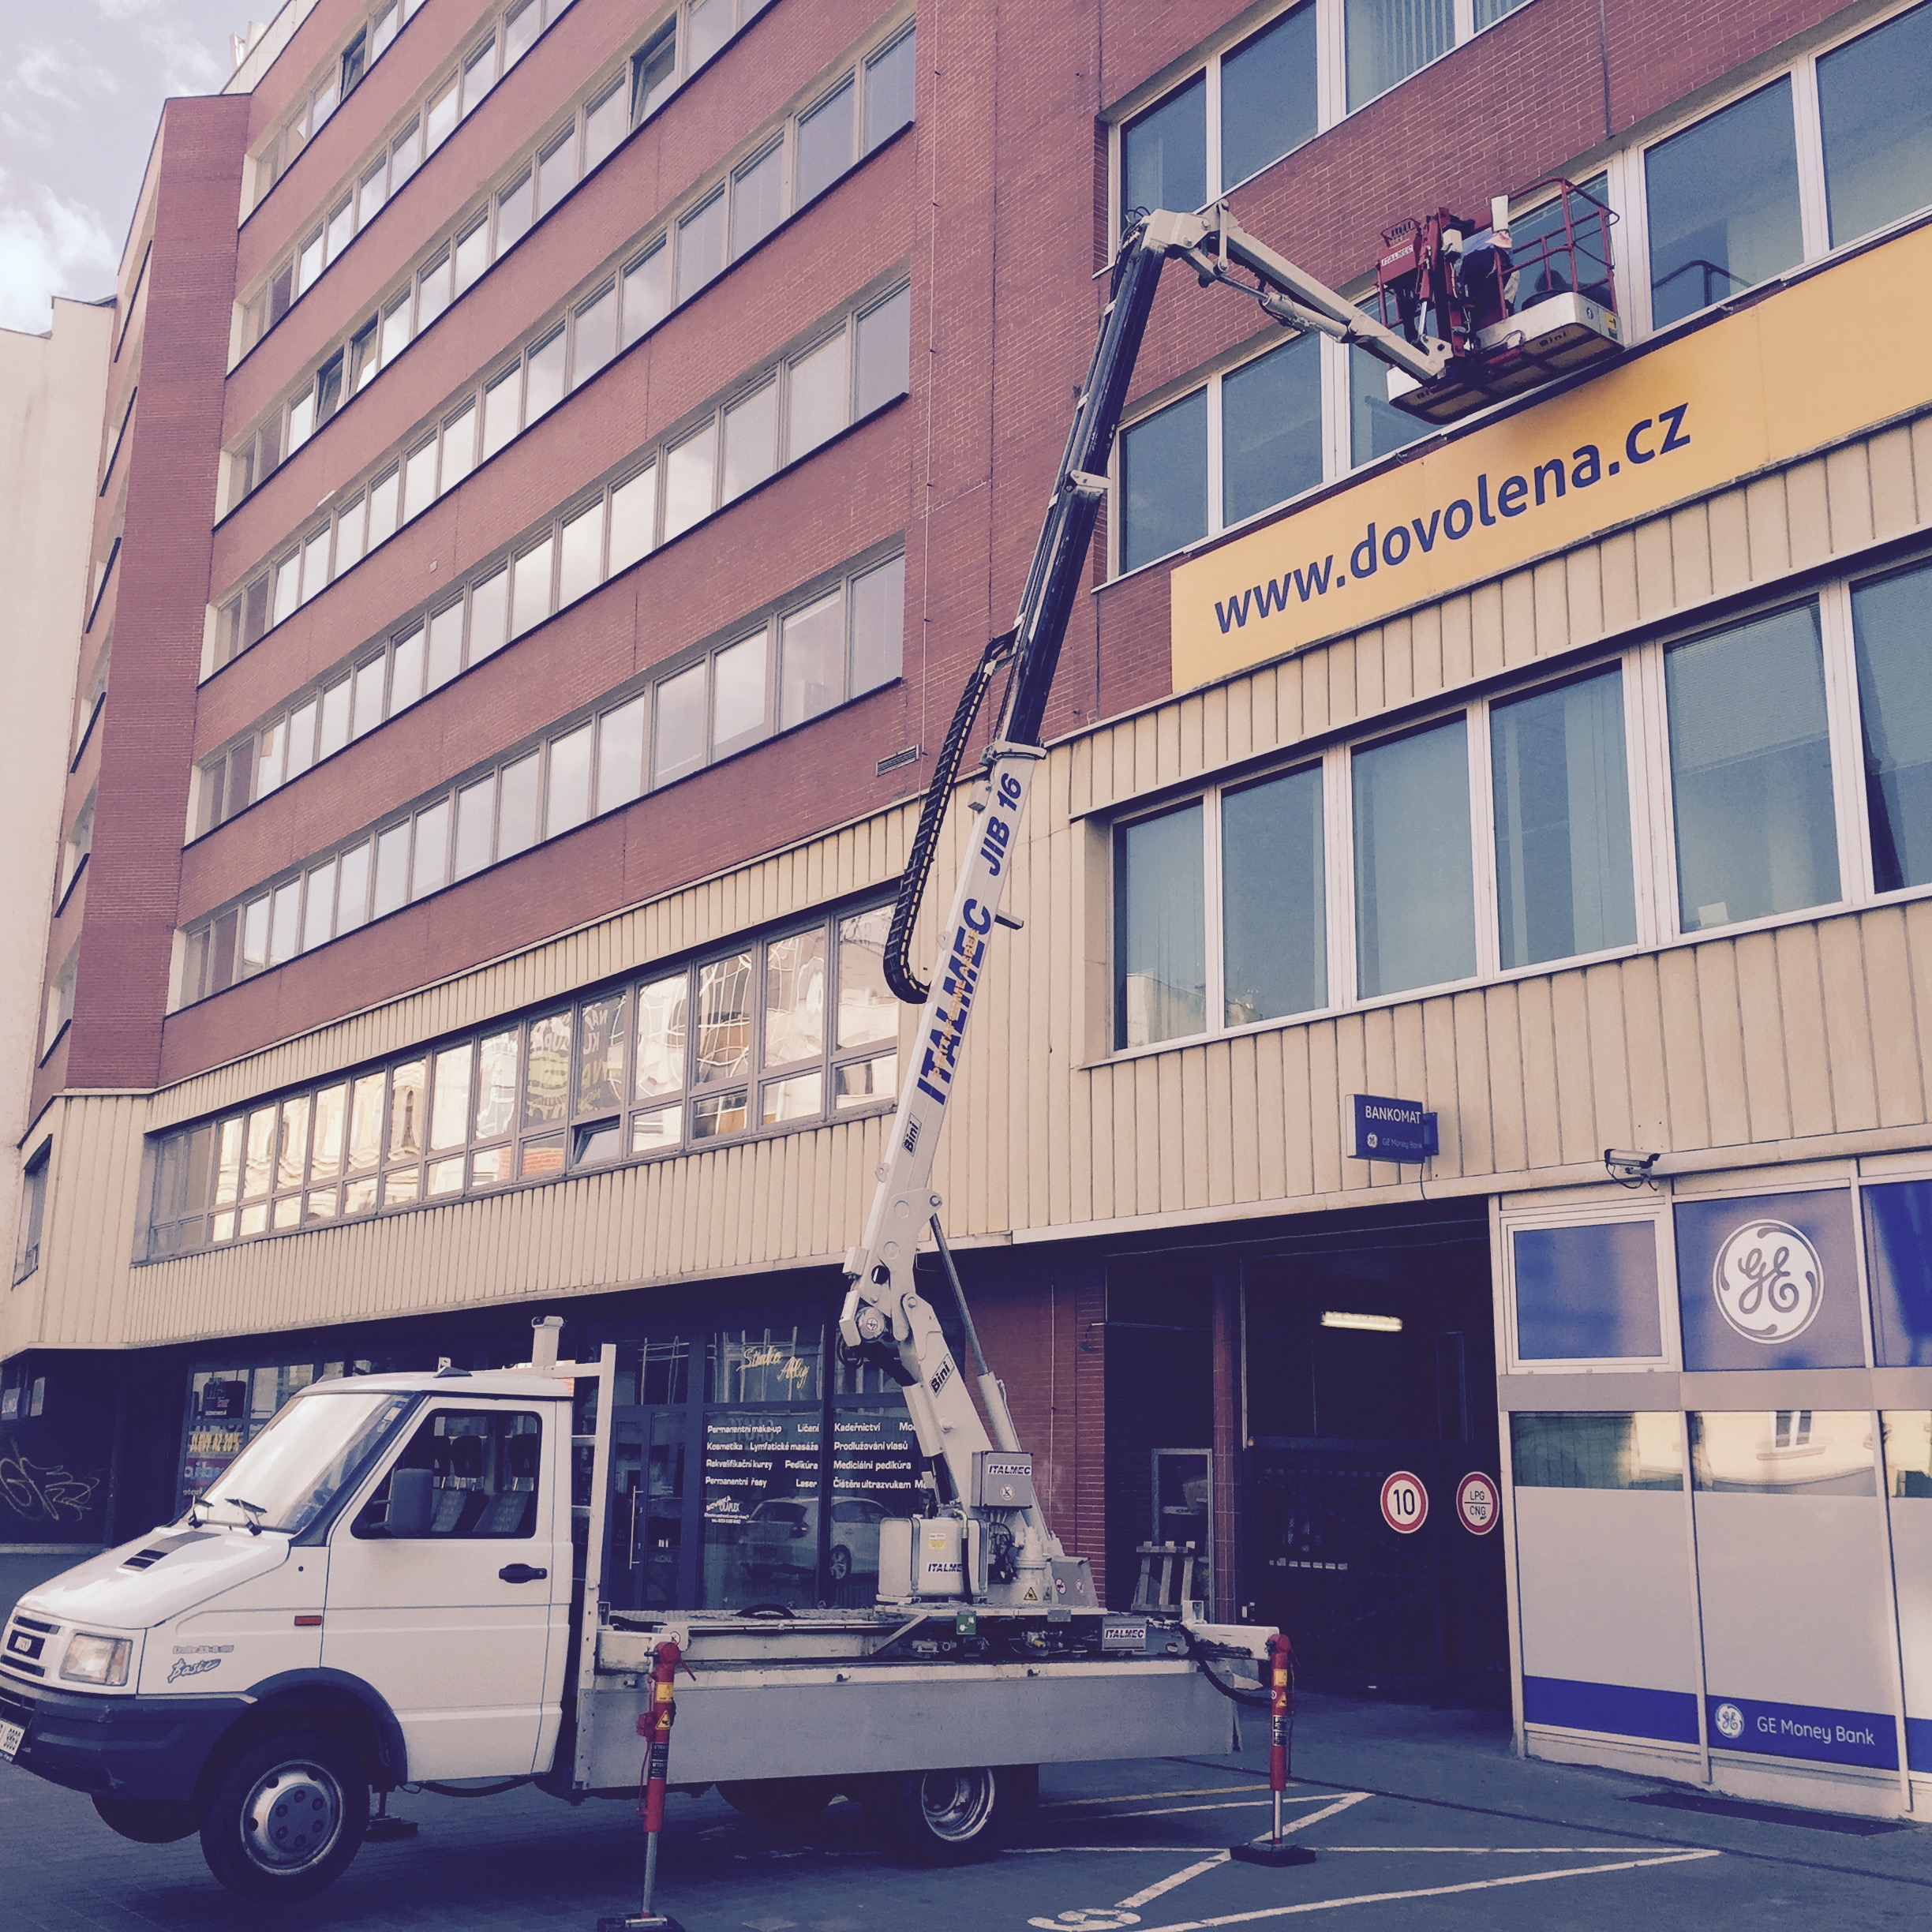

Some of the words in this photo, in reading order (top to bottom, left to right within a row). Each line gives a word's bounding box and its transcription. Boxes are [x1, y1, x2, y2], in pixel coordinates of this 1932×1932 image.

[1215, 402, 1691, 634] www.dovolena.cz
[917, 898, 991, 1106] ITALMEC
[980, 816, 1010, 876] JIB
[997, 773, 1022, 811] 16
[1365, 1105, 1421, 1124] BANKOMAT
[904, 1121, 919, 1153] Bini
[931, 1361, 950, 1394] Bini
[989, 1466, 1031, 1474] ITALMEC
[796, 1479, 818, 1488] Laser
[1394, 1489, 1415, 1515] 10
[1470, 1491, 1485, 1500] LPG
[1470, 1506, 1486, 1515] CNG
[928, 1563, 962, 1572] ITALME
[1105, 1630, 1144, 1638] ITALMEC
[167, 1658, 222, 1683] Basic
[1757, 1717, 1777, 1734] GE
[1781, 1719, 1831, 1744] Money
[1837, 1725, 1875, 1746] Bank
